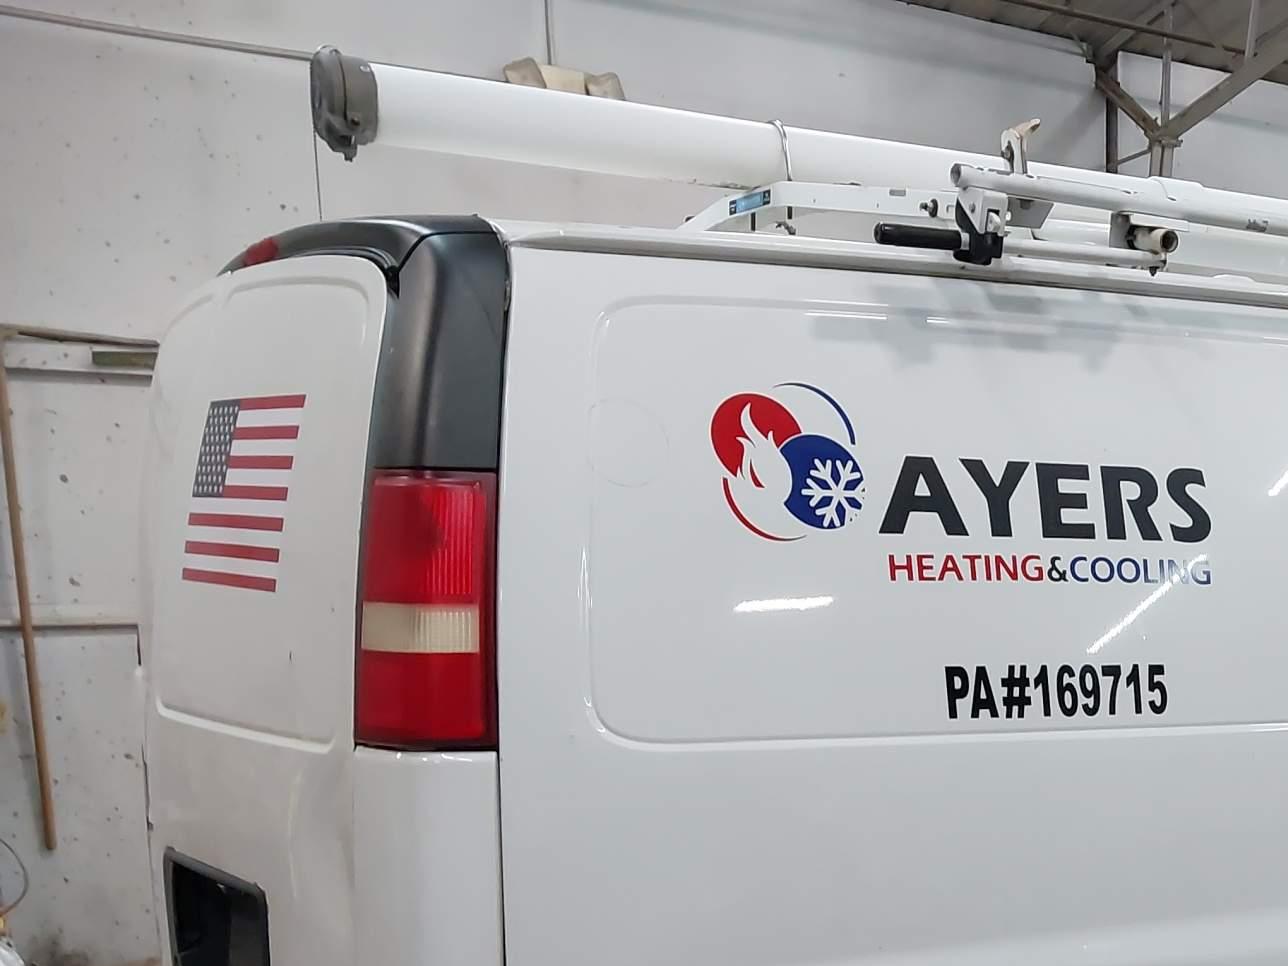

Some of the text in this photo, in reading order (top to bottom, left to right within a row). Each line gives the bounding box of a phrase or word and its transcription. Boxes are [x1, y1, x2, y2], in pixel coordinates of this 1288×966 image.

[879, 456, 1212, 543] AYERS
[888, 554, 1212, 586] HEATING&COOLING
[944, 663, 1168, 720] PA#169715
